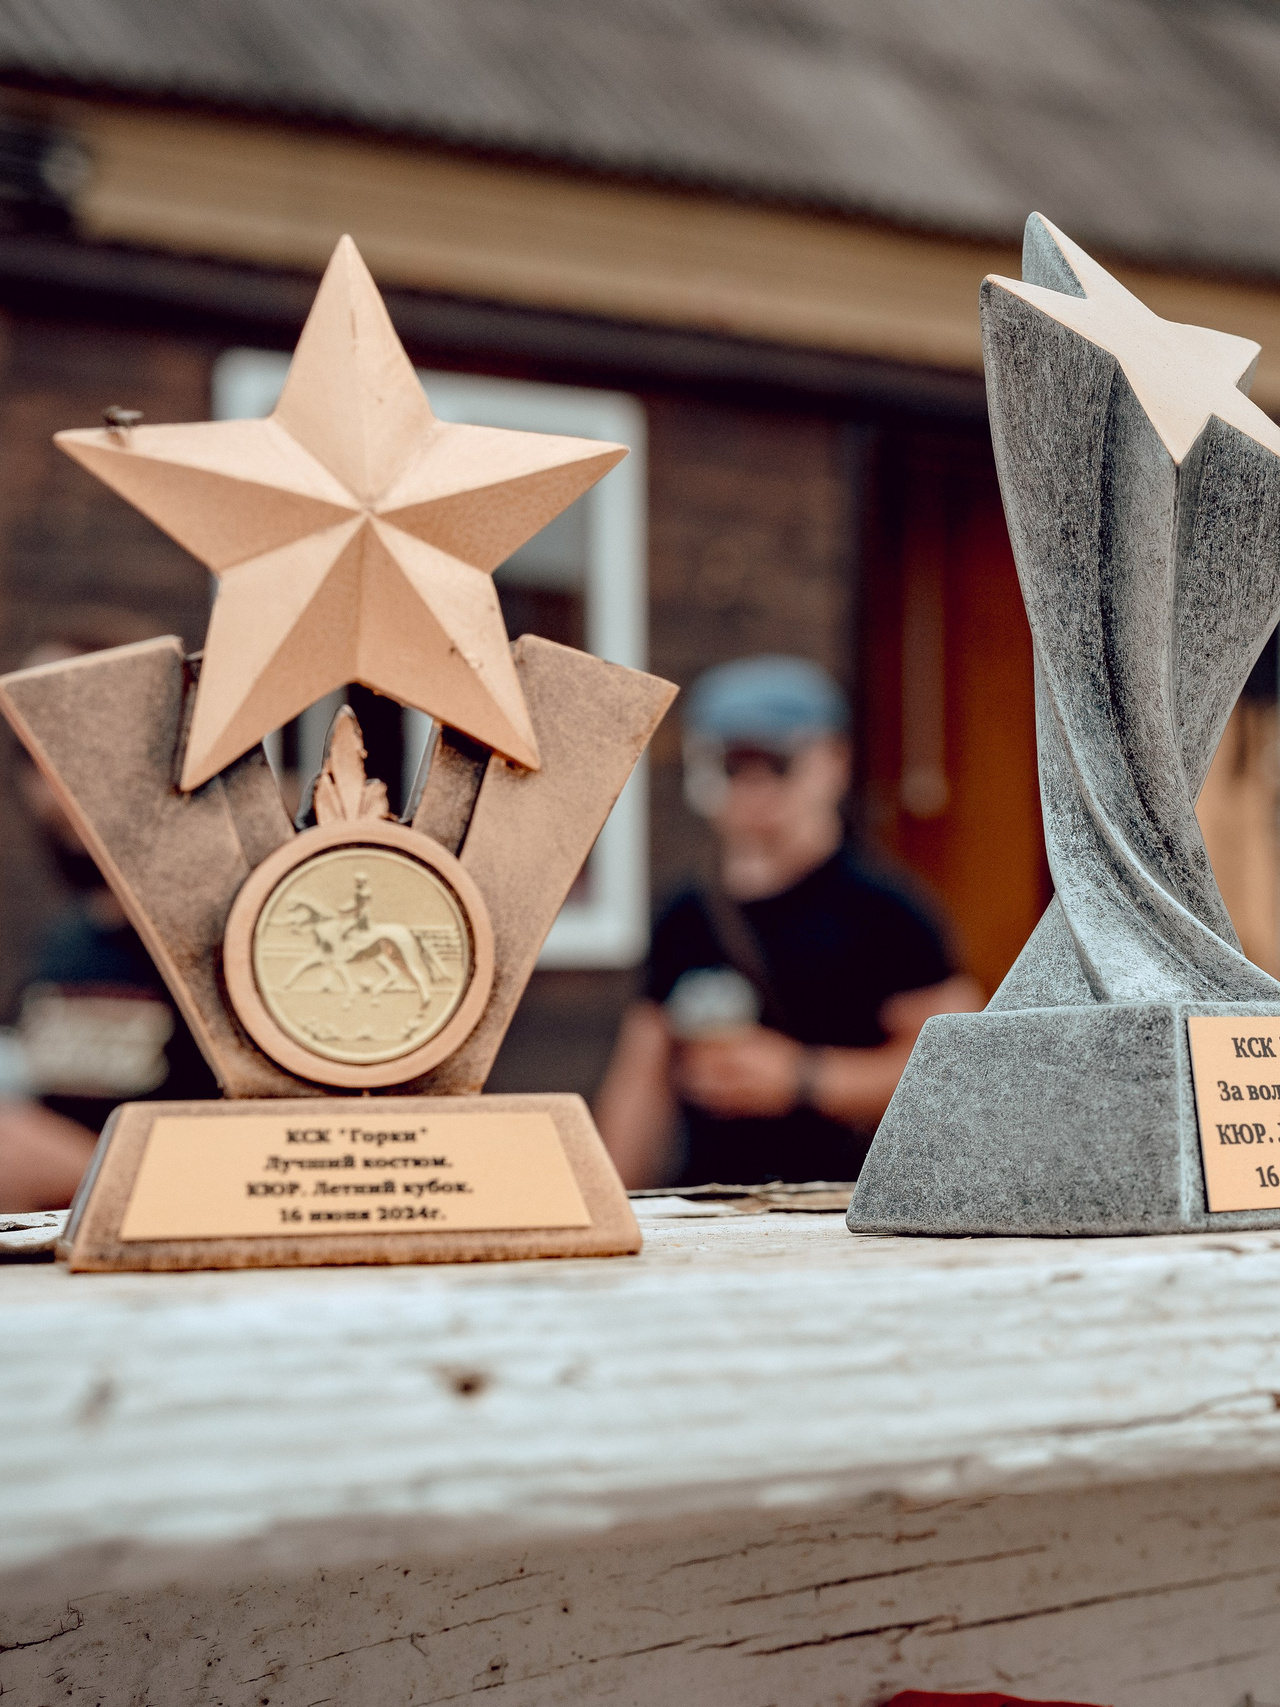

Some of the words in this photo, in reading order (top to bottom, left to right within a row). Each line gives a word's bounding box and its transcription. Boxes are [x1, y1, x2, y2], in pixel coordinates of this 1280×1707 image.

[1232, 1037, 1277, 1058] КСК
[1217, 1080, 1244, 1101] За
[286, 1129, 332, 1144] КСК
[1216, 1123, 1273, 1145] КЮР.
[264, 1154, 356, 1172] Лучший
[363, 1155, 453, 1169] костюм.
[1255, 1165, 1279, 1187] 16
[313, 1179, 396, 1196] Летний
[404, 1179, 473, 1198] кубок.
[280, 1207, 301, 1223] 16
[309, 1208, 369, 1221] июня
